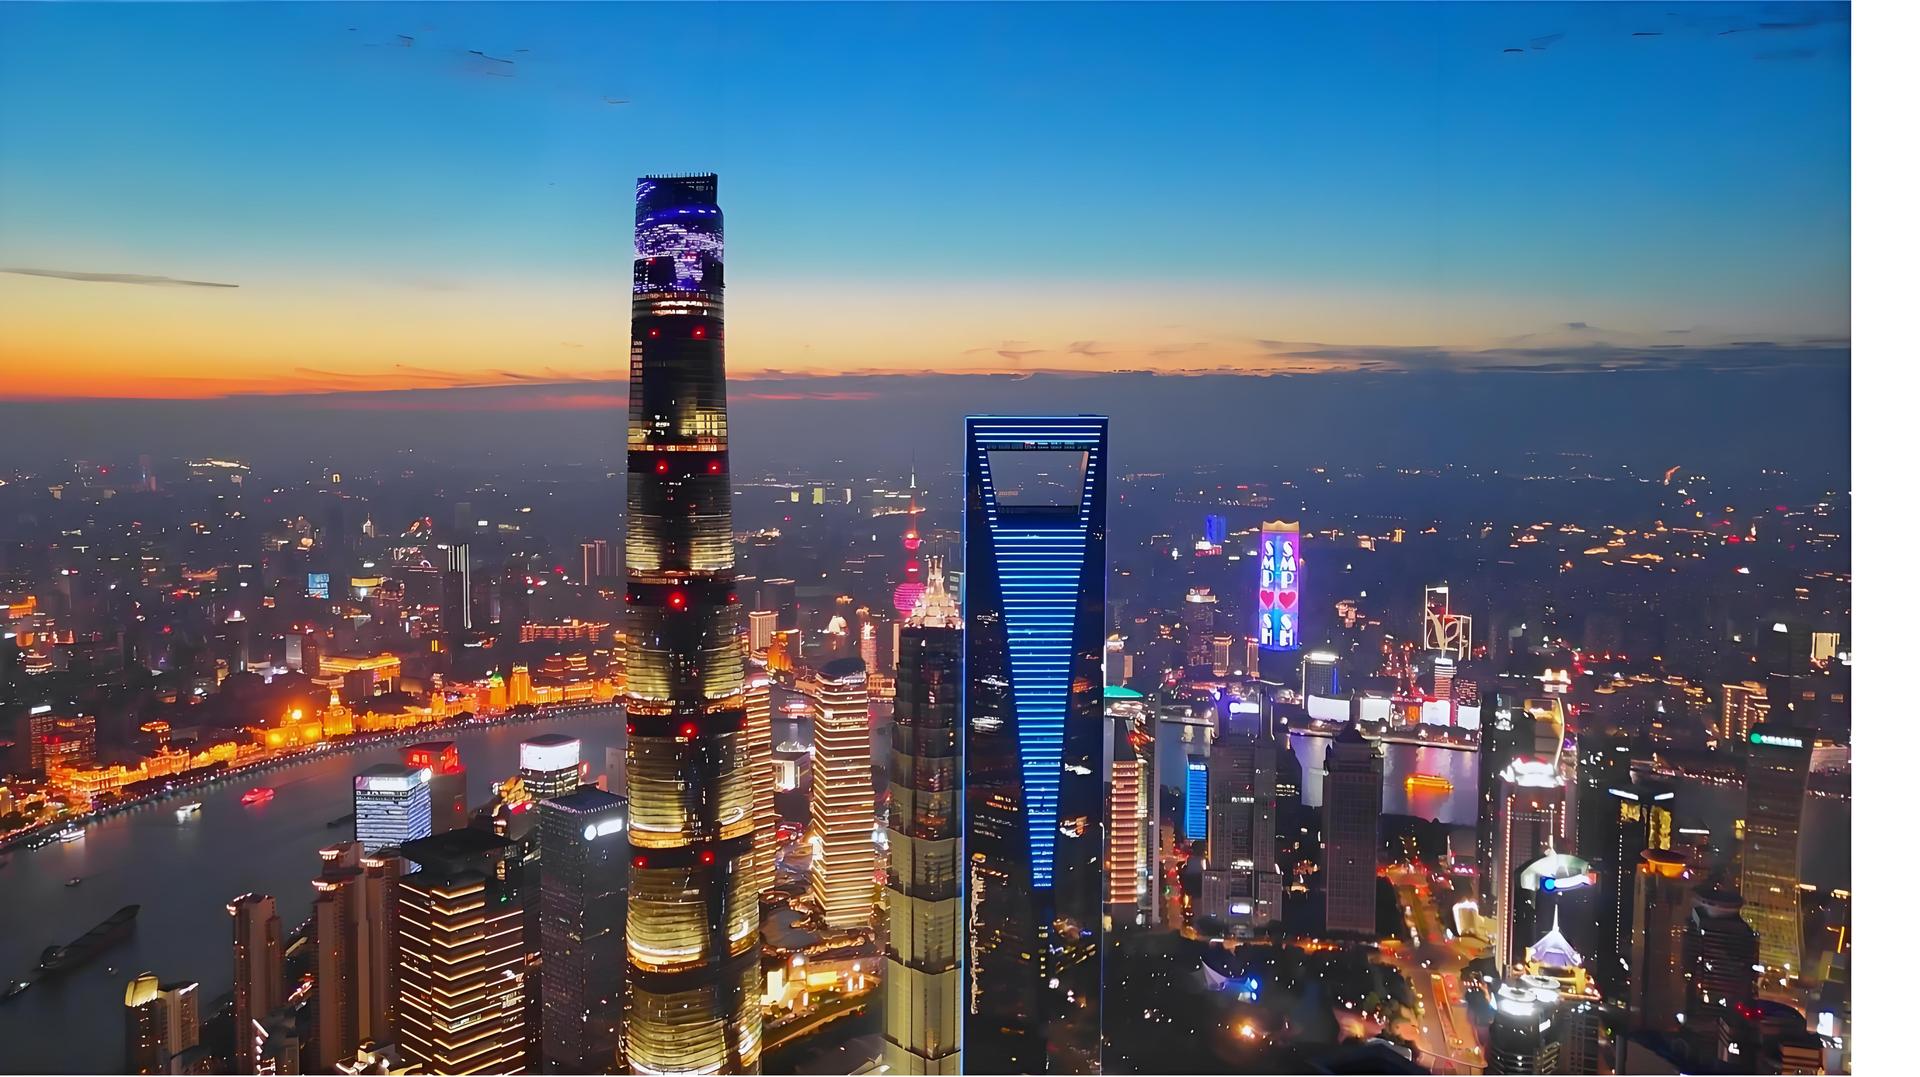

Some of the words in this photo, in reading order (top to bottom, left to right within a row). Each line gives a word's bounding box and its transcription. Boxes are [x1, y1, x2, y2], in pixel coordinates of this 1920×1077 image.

[1261, 540, 1275, 588] SMP
[1280, 541, 1297, 589] SMP
[1261, 613, 1273, 646] SH
[1279, 613, 1294, 647] SH
